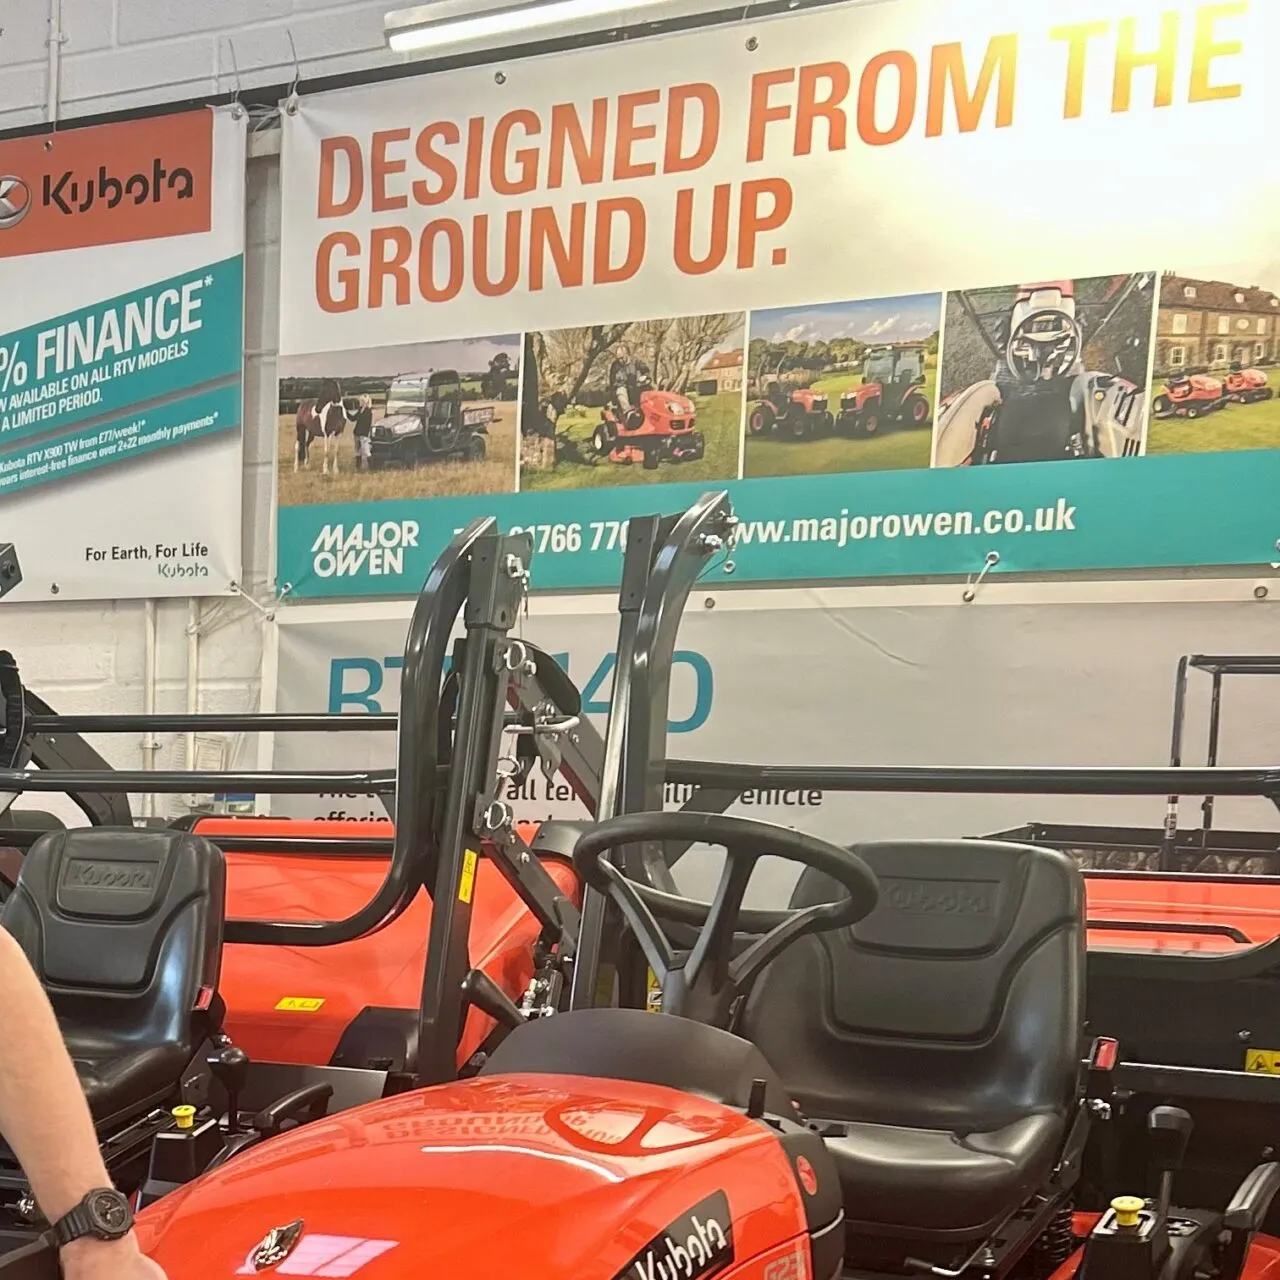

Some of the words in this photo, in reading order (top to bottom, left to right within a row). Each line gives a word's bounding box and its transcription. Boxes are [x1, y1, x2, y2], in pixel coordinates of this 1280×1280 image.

[317, 82, 720, 219] DESIGNED
[745, 33, 1018, 163] FROM
[1049, 1, 1250, 119] THE
[42, 158, 193, 215] Kubota
[315, 196, 646, 313] GROUND
[673, 177, 793, 275] UP.
[8, 377, 69, 411] AVAILABLE
[71, 372, 89, 390] ON
[90, 366, 112, 385] ALL
[113, 358, 137, 378] RTV
[138, 340, 189, 371] MODELS
[1, 416, 11, 432] A
[12, 401, 57, 429] LIMITED
[58, 388, 104, 416] PERIOD.
[0, 456, 26, 476] Kubota
[26, 452, 44, 466] RTV
[63, 441, 78, 456] TW
[79, 437, 98, 453] from
[20, 459, 66, 480] interest-free
[68, 450, 98, 468] finance
[99, 446, 117, 459] over
[138, 426, 171, 447] monthly
[311, 520, 419, 552] MAJOR
[732, 498, 1076, 546] ww.majorowen.co.uk
[85, 547, 107, 561] For
[111, 545, 152, 560] Earth,
[155, 544, 177, 558] For
[182, 542, 208, 557] Life
[158, 562, 209, 578] Kubota
[314, 548, 403, 577] OWEN
